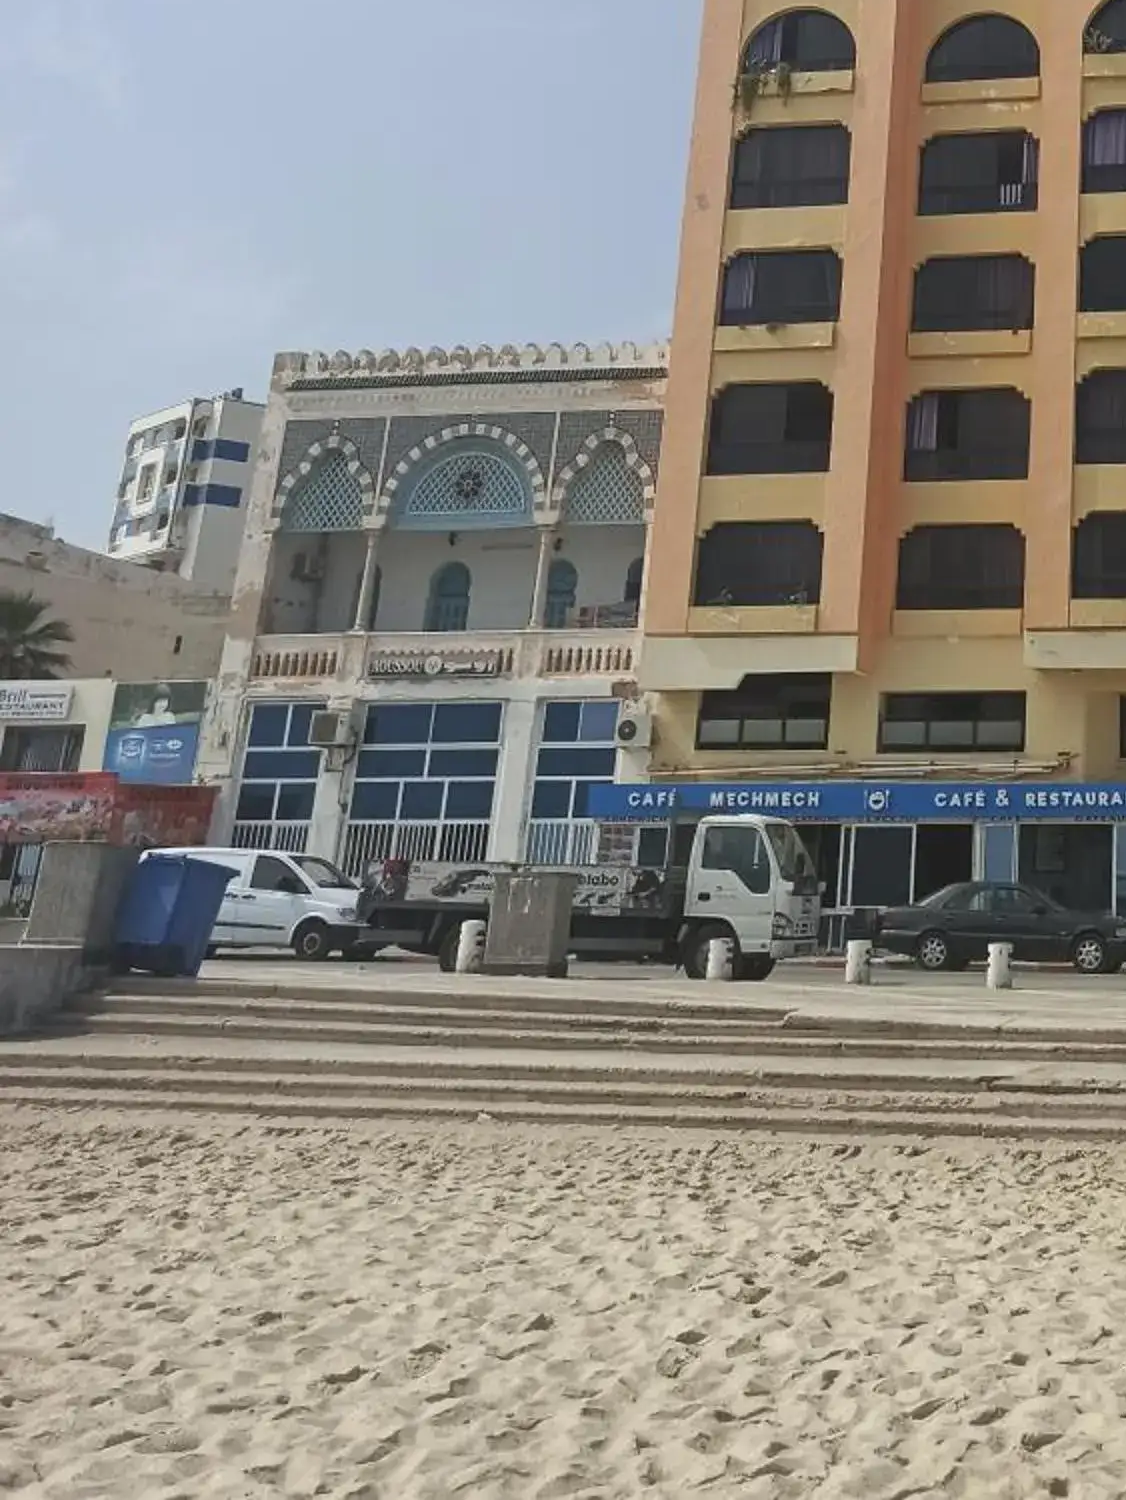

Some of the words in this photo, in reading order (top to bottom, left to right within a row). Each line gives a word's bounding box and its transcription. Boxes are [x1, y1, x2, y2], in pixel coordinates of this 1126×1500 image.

[709, 791, 820, 807] MECHMECH
[934, 789, 985, 807] CAFÉ
[995, 789, 1009, 806] &
